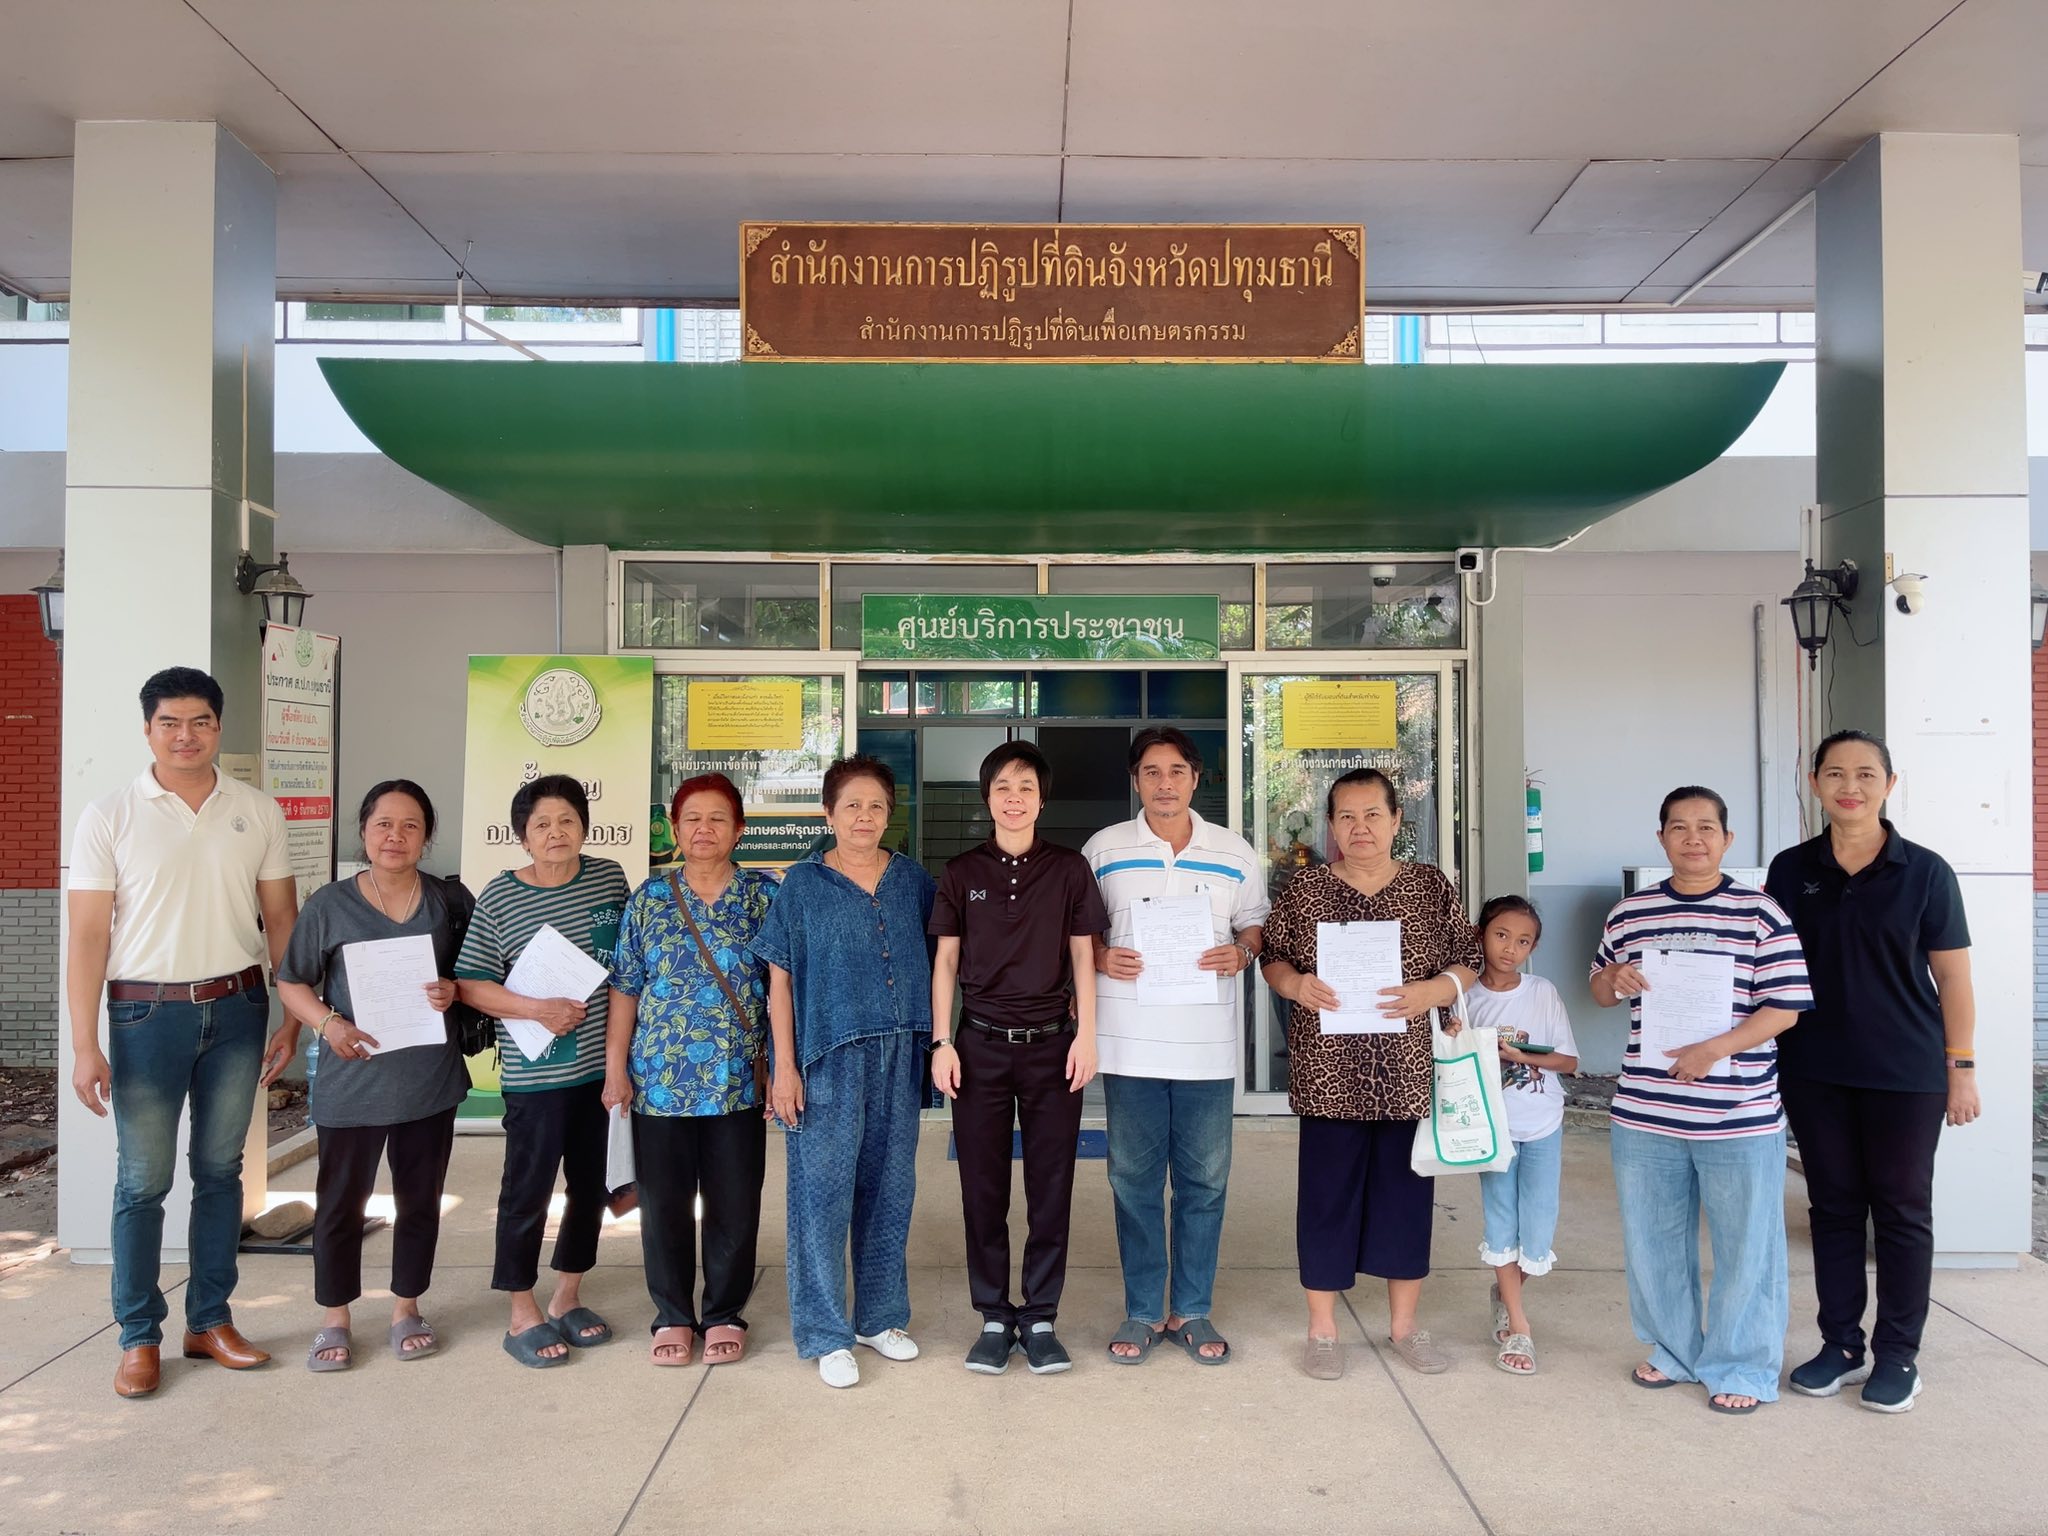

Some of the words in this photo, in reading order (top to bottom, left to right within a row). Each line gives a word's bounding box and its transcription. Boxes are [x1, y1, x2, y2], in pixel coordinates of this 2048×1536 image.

[769, 229, 1334, 303] สำนักงานการปฏิรูปที่ดินจังหวัดปทุมธานี
[858, 308, 1247, 350] สำนักงานการปฏิรูปที่ดินเพื่อเกษตรกรรม
[897, 606, 1185, 649] ศูนย์บริการประชาชน
